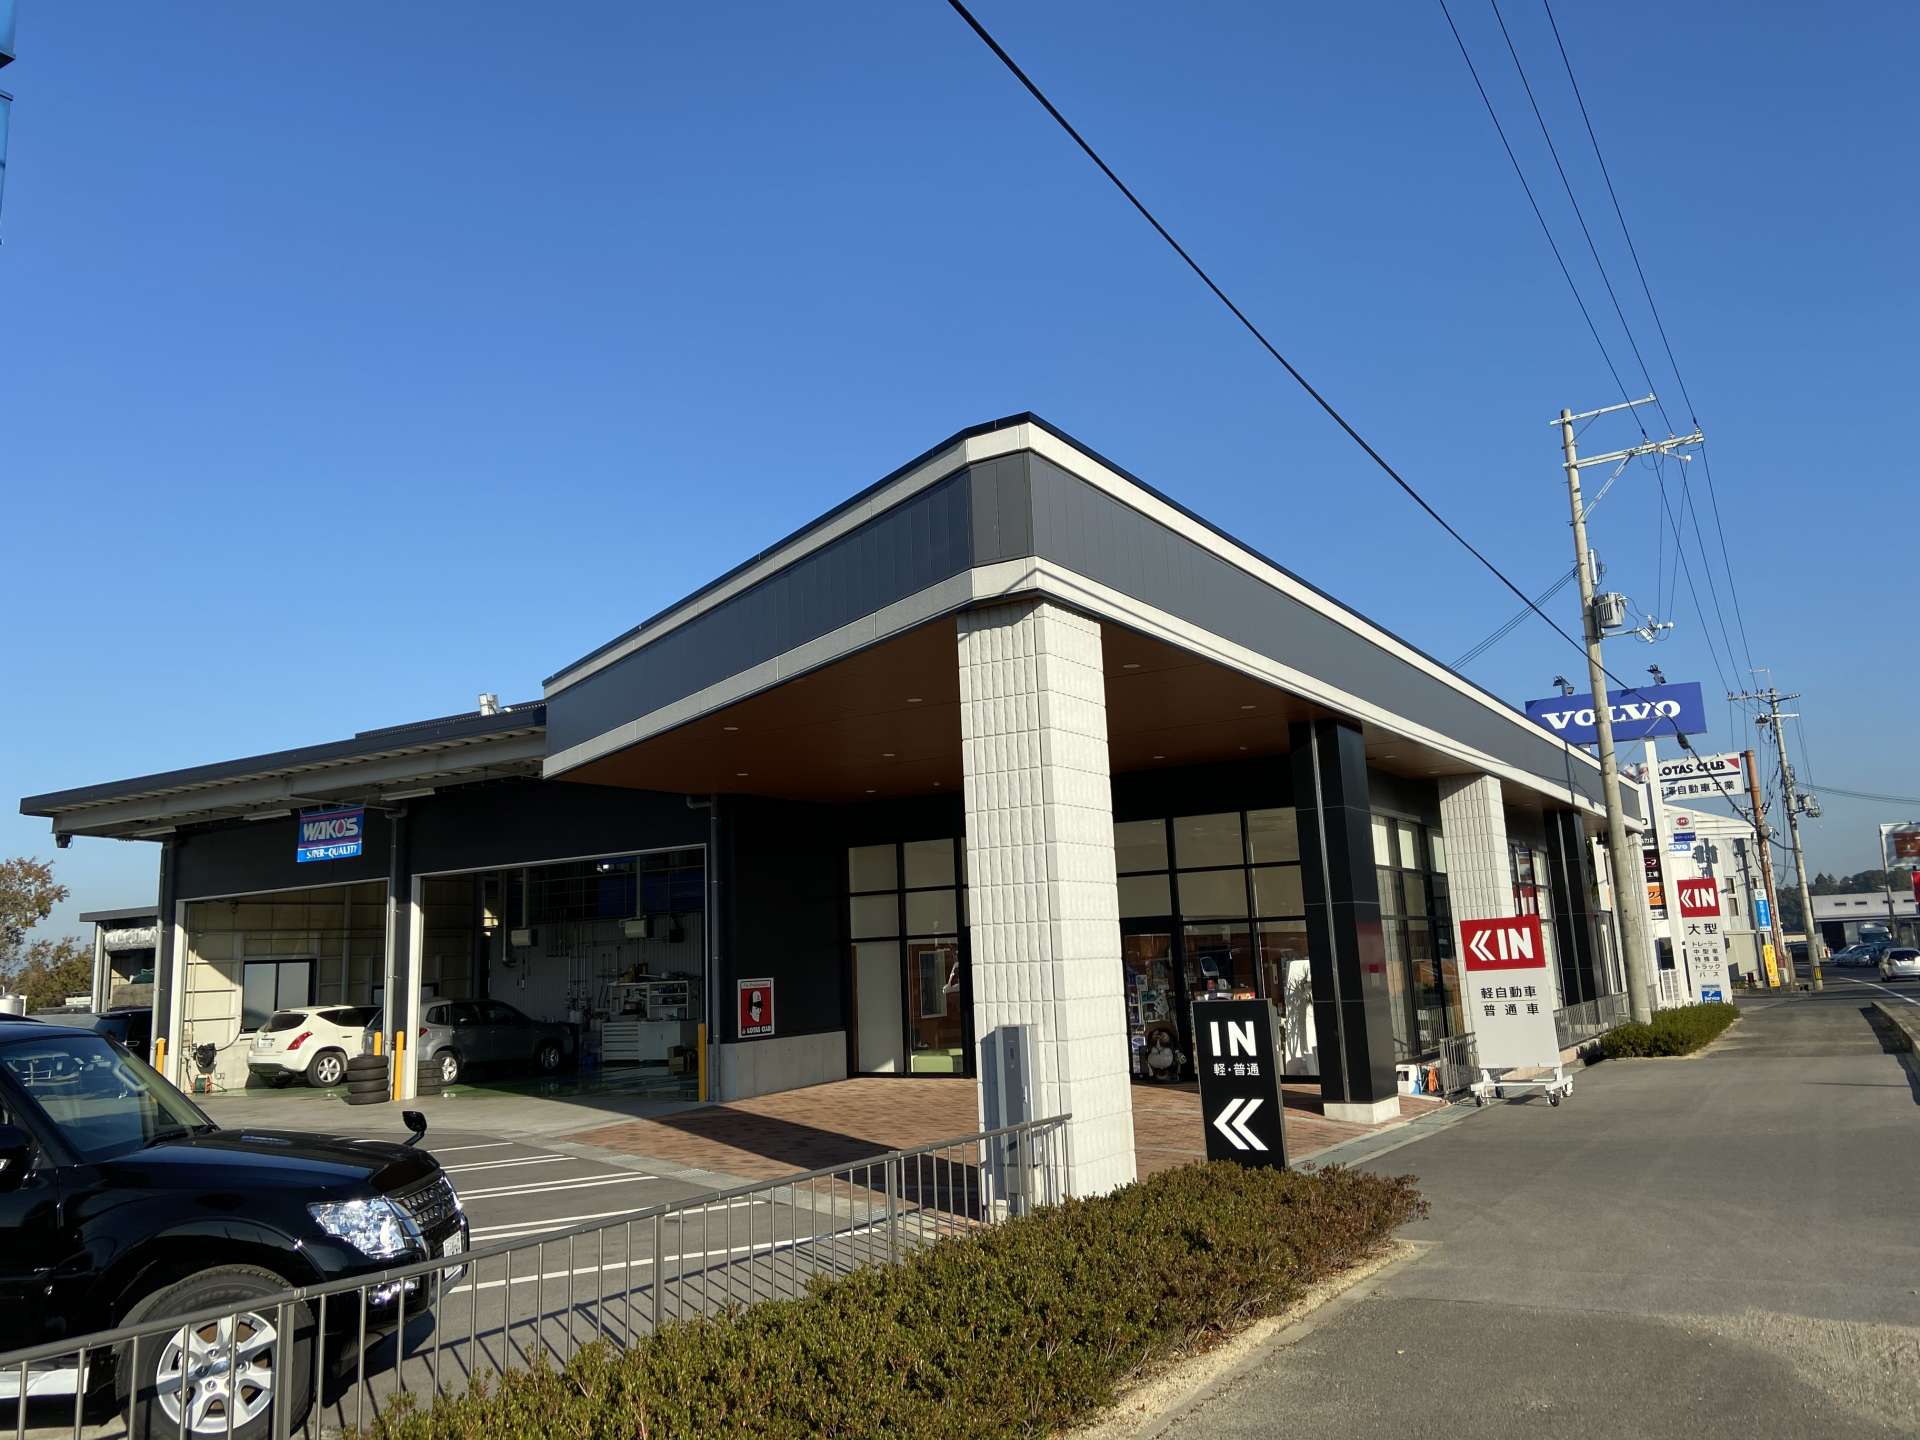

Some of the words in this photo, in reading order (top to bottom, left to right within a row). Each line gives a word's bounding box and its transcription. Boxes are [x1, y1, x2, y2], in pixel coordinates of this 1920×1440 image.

[1542, 700, 1680, 730] VOLVO
[1696, 760, 1726, 772] CLUB
[1693, 887, 1716, 908] IN
[1688, 923, 1718, 936] 大型
[1496, 927, 1534, 960] IN
[1480, 985, 1537, 999] 軽自動車
[1483, 1003, 1539, 1017] 普通車
[1210, 1021, 1258, 1057] IN
[1213, 1063, 1260, 1076] 軽・普通
